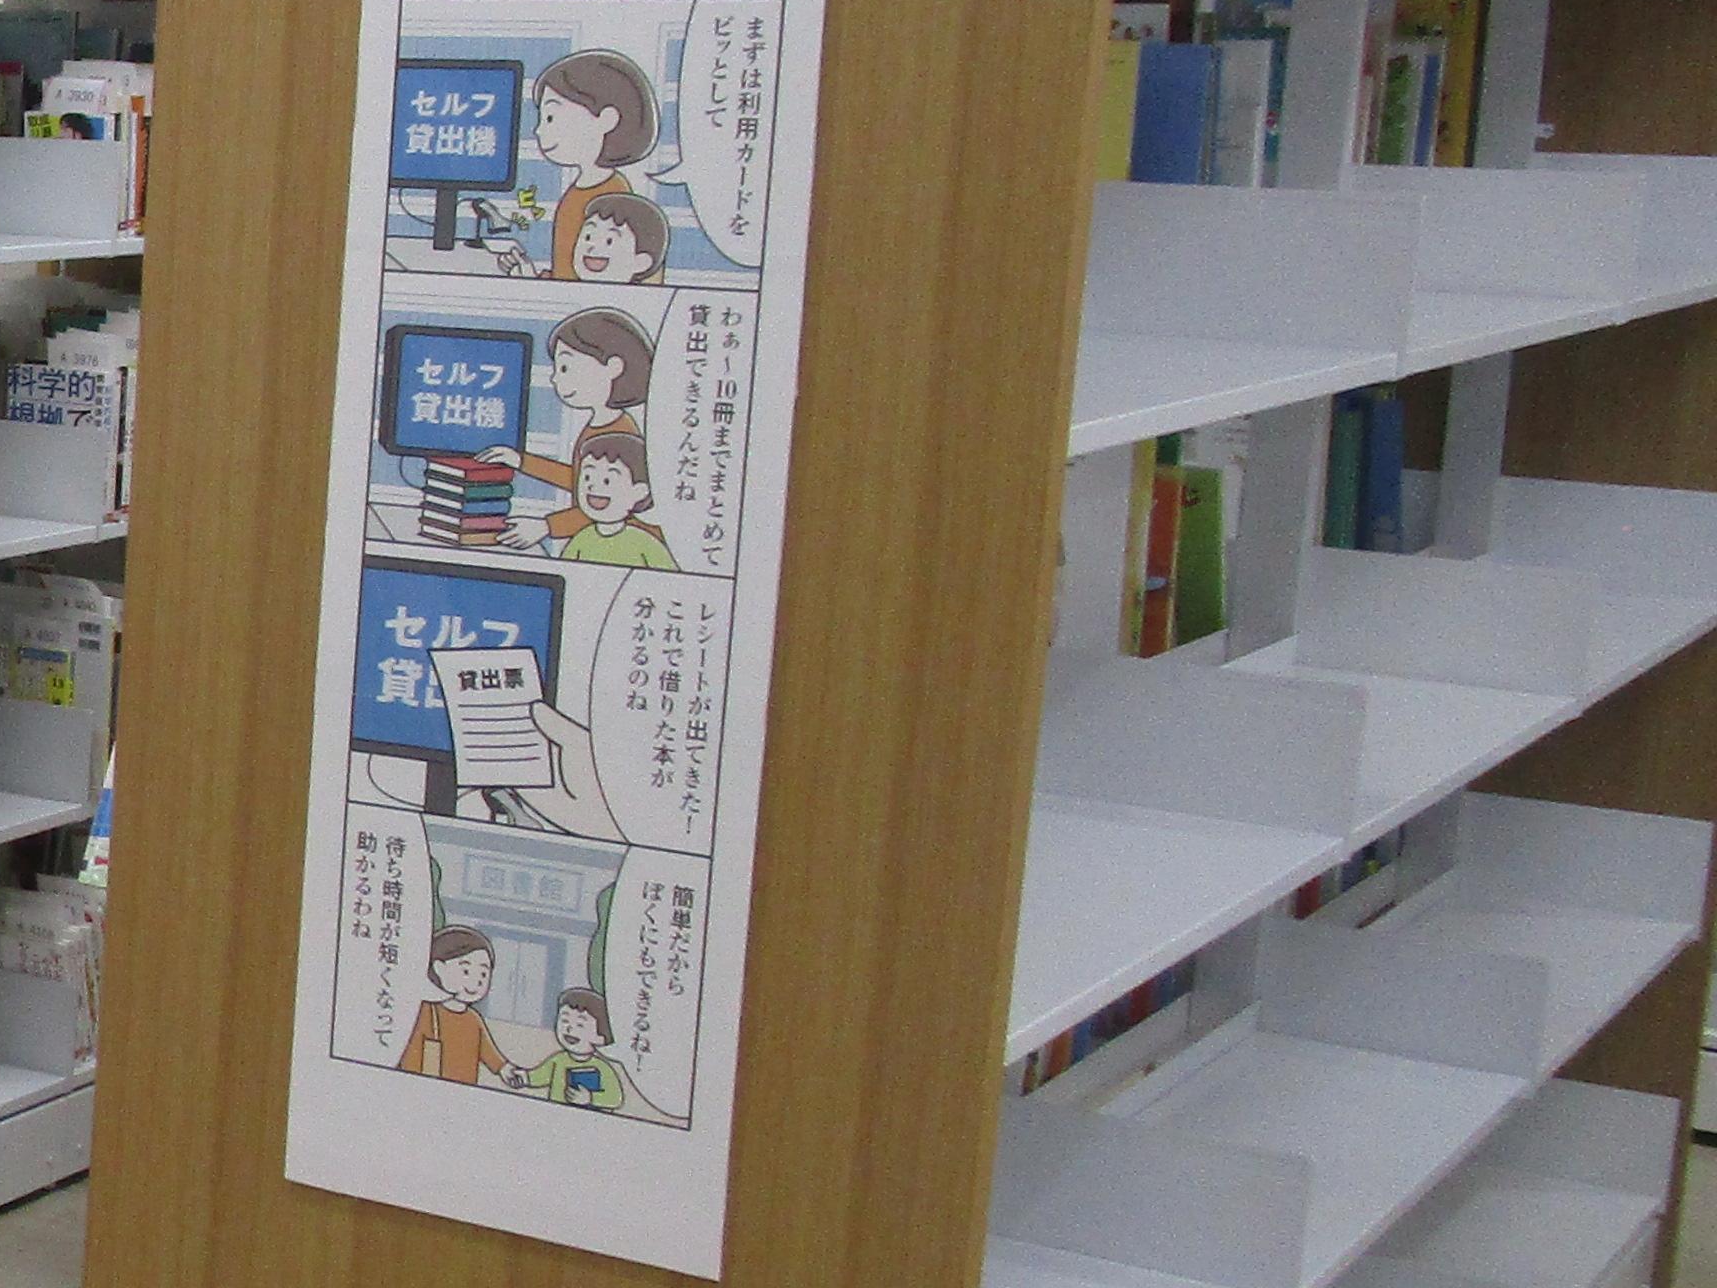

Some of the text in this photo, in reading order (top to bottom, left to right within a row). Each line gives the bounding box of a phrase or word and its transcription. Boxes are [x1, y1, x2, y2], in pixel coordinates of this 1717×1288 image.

[410, 88, 497, 119] セルフ
[729, 15, 769, 236] まずは利用カードを
[405, 122, 497, 158] 貸出機
[8, 365, 97, 402] 科学的
[415, 357, 506, 387] セルフ
[410, 392, 506, 429] 貸出機
[673, 304, 712, 503] 貸出できるんだね
[383, 605, 521, 650] セルフ
[625, 597, 657, 712] 分かるのね
[457, 667, 526, 692] 貸出票
[649, 600, 685, 789] これで借りた本が
[350, 829, 378, 940] 助かるわね
[480, 863, 565, 898] 図書館
[372, 835, 406, 1048] 待ち時間が短くなって
[667, 884, 695, 996] 簡単だから
